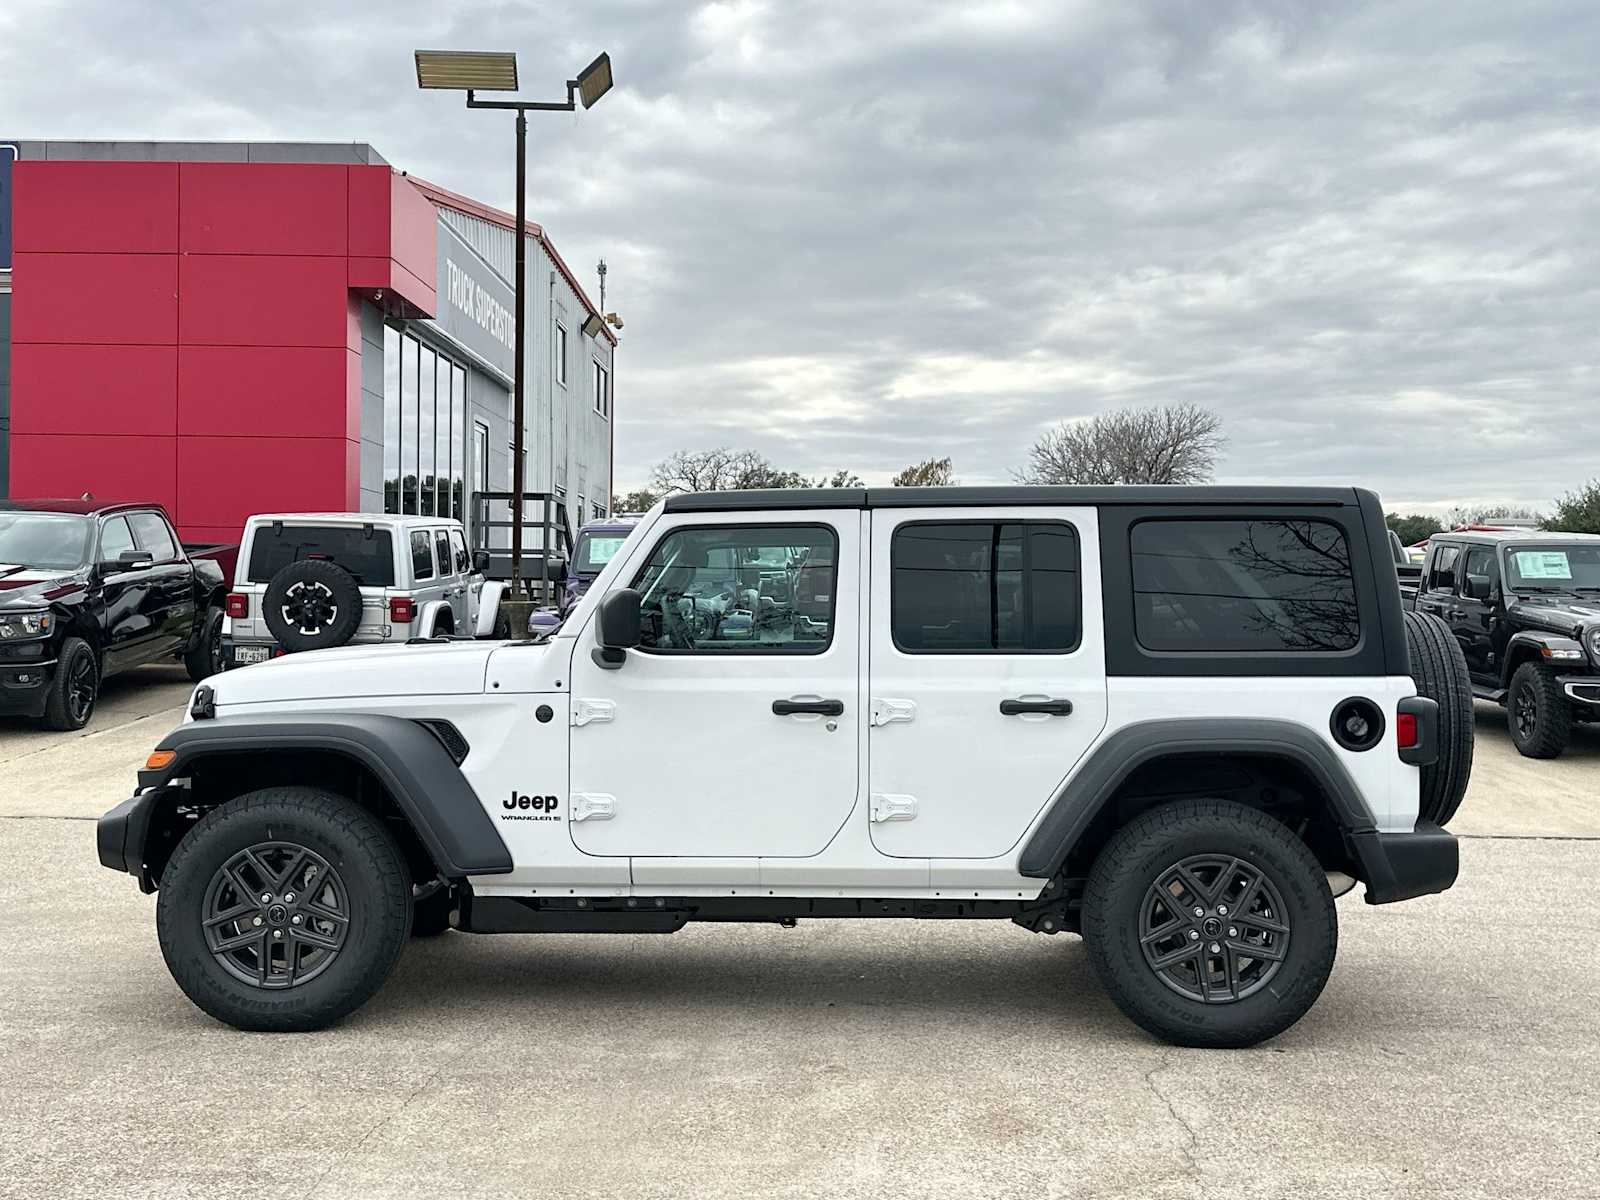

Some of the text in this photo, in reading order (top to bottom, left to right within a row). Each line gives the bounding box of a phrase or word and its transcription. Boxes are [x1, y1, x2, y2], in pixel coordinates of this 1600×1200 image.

[446, 257, 515, 351] TRUCK SUPERSTO
[502, 790, 559, 813] Jeep
